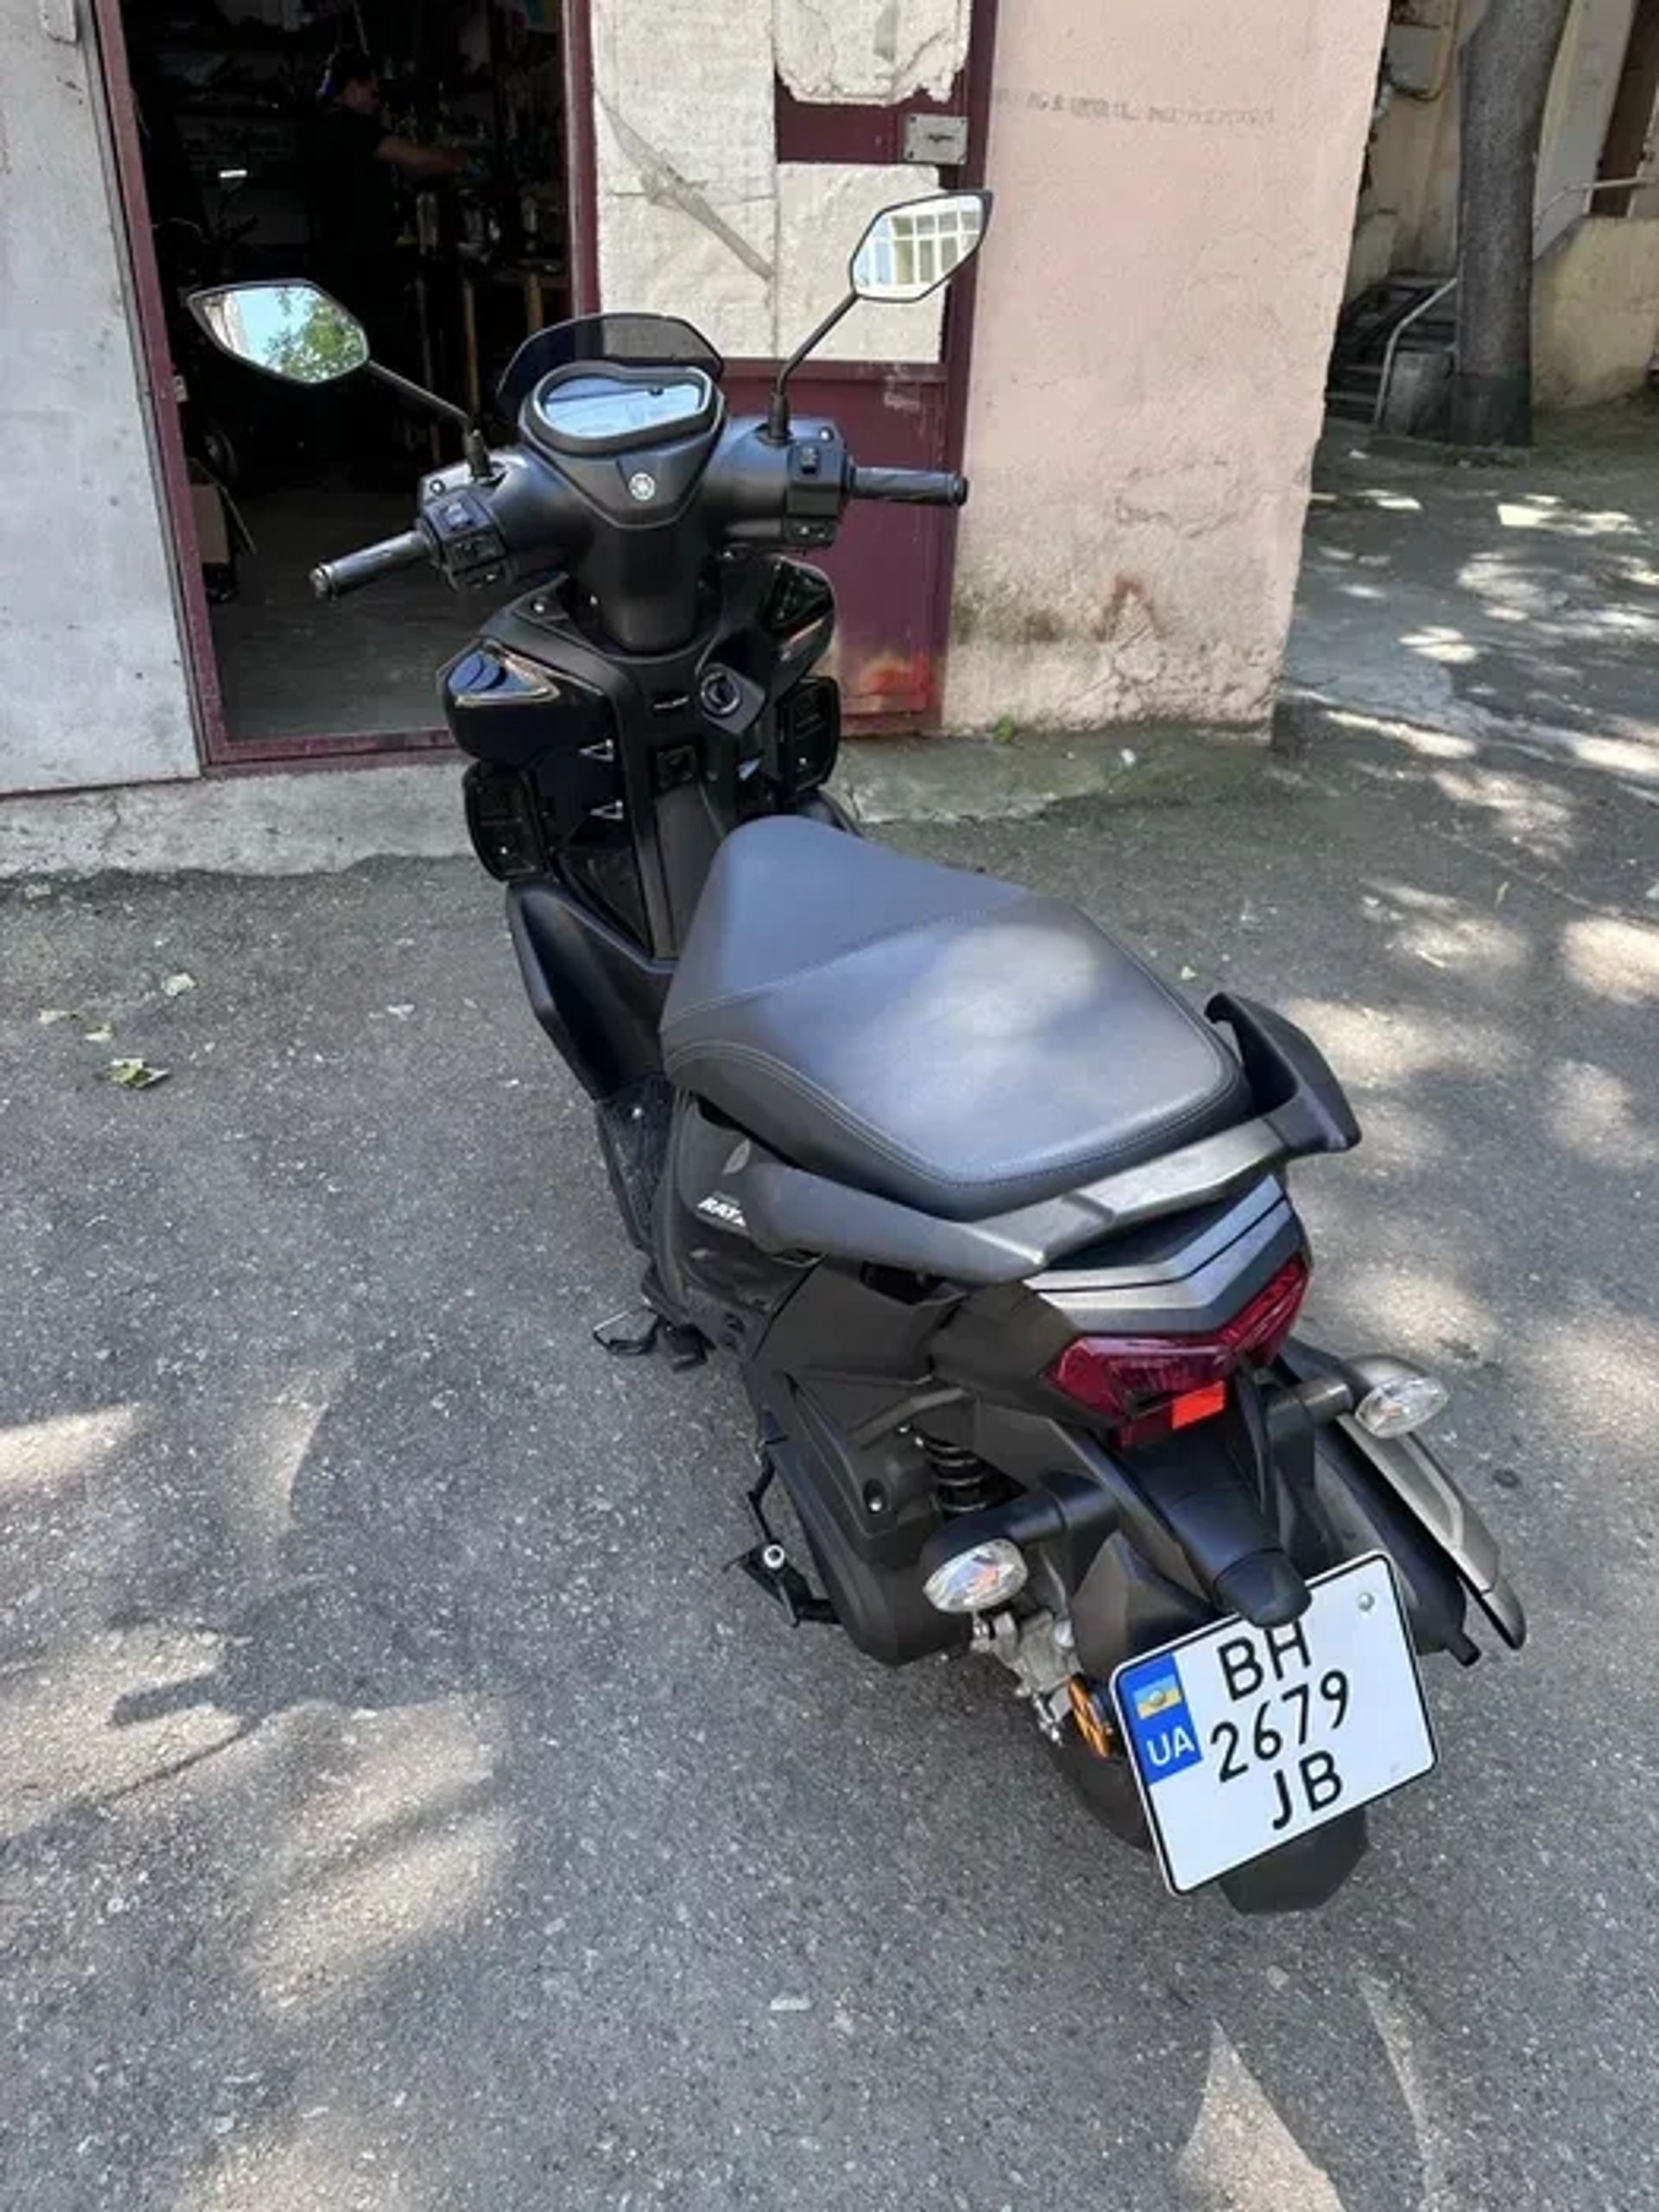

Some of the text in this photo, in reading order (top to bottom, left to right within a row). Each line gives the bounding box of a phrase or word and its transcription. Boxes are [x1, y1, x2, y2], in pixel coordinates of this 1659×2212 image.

[1217, 1620, 1312, 1702] BH
[1146, 1726, 1196, 1767] UA
[1210, 1669, 1350, 1783] 2679
[1272, 1750, 1343, 1831] JB
